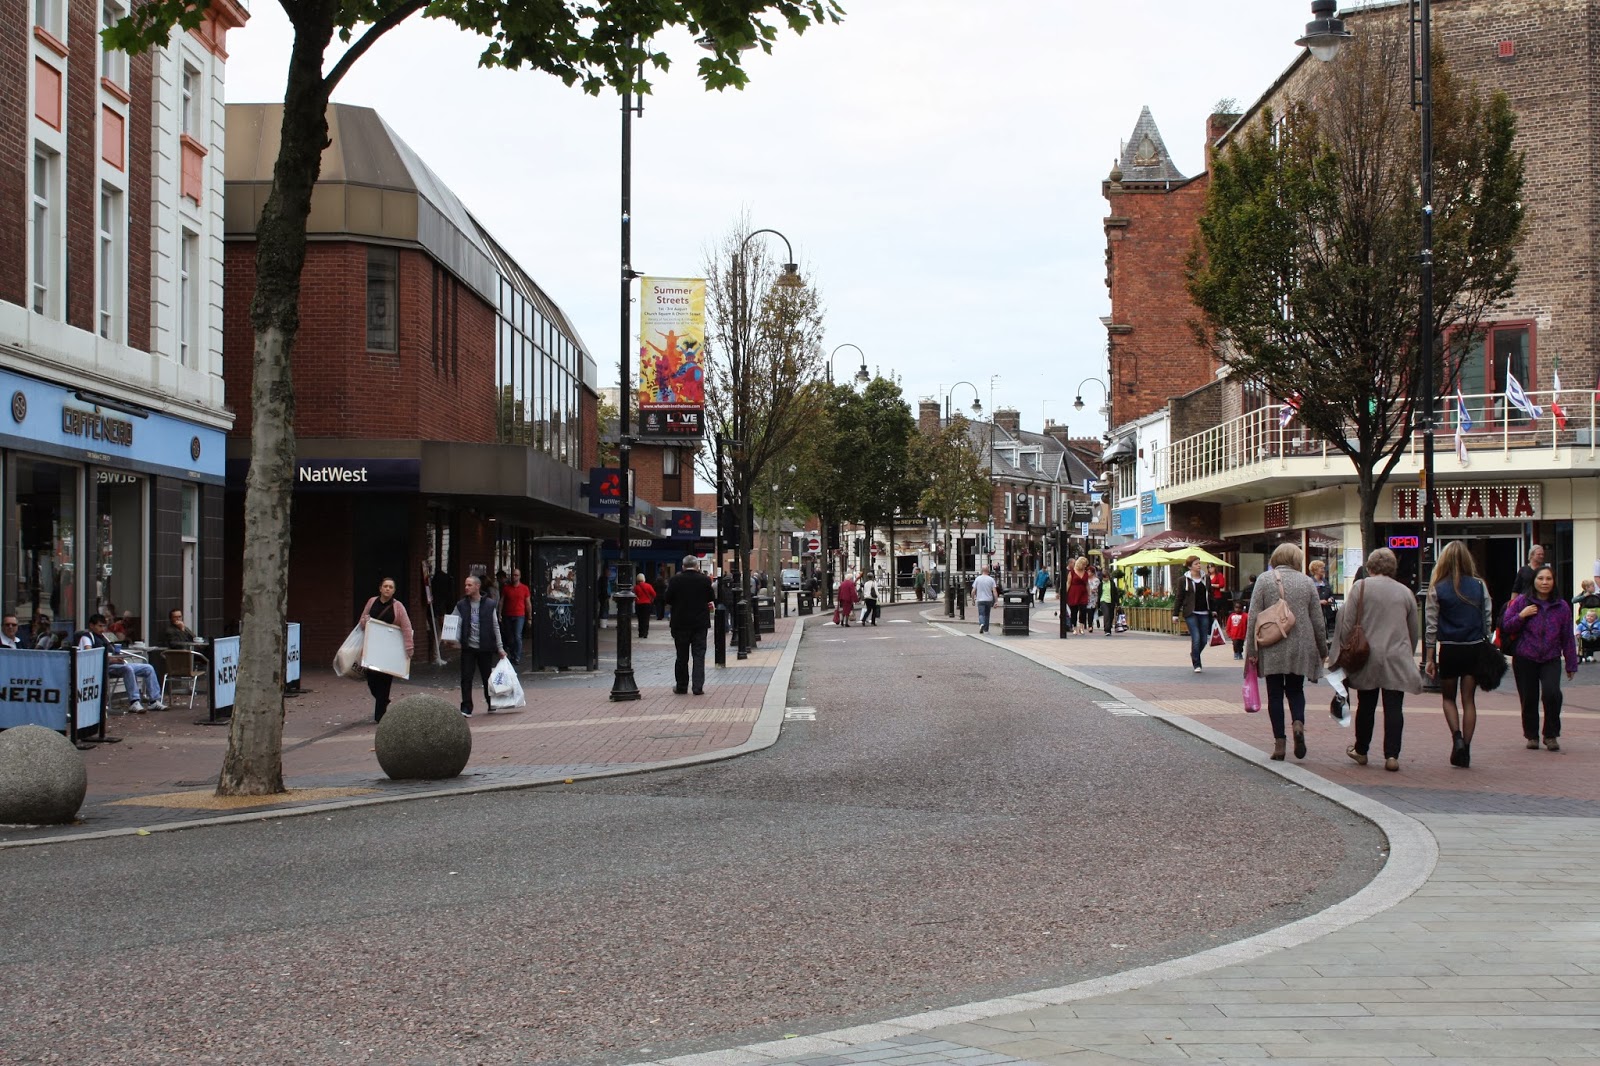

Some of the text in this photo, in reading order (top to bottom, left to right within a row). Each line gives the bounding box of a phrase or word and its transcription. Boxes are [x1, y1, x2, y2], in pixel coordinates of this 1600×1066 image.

[653, 285, 692, 294] Summer
[656, 295, 689, 304] Streets
[101, 415, 133, 446] NERO
[299, 466, 368, 482] NatWest
[628, 539, 652, 547] TFRED
[1390, 538, 1418, 547] OPEN
